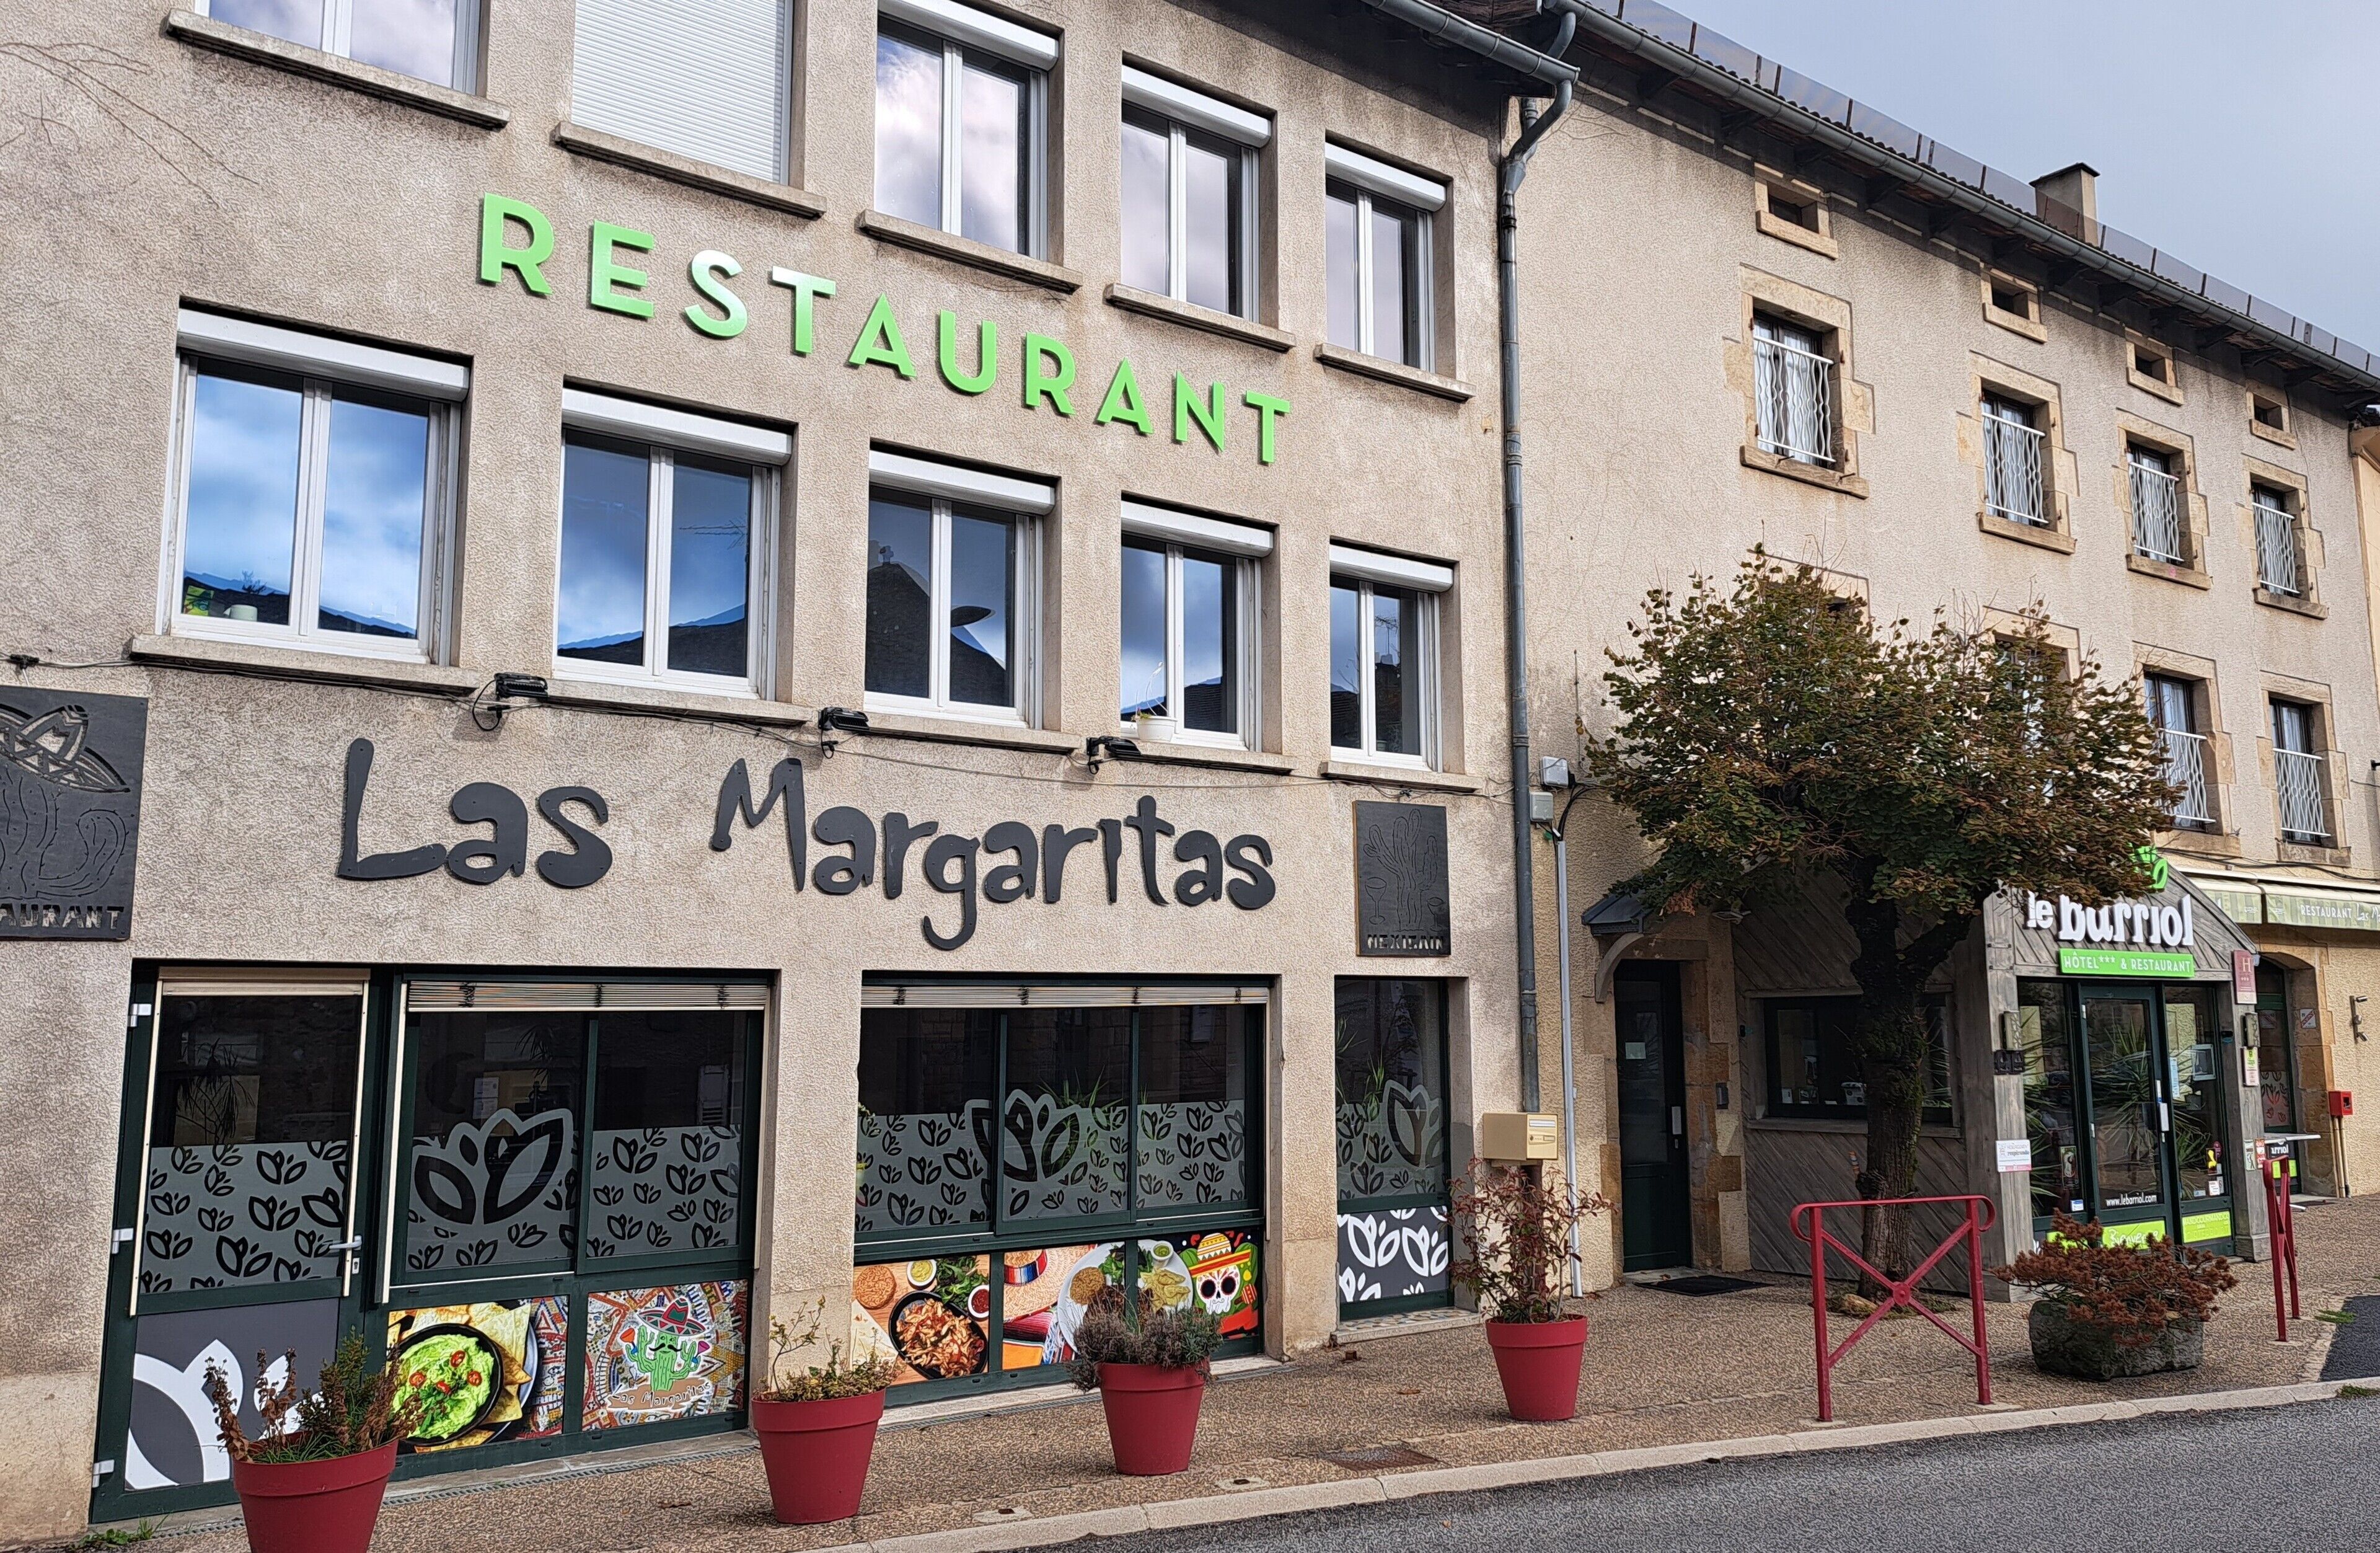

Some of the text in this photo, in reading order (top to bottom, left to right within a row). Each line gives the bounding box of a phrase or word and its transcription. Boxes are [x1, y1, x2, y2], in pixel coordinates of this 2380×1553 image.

[480, 192, 1291, 464] RESTAURANT
[336, 738, 1276, 951] Las Margaritas
[2027, 888, 2053, 929] le
[2300, 903, 2352, 919] RESTAURANT
[2356, 903, 2369, 921] Las
[1367, 934, 1445, 950] MEXICAIN
[2063, 950, 2191, 973] HÔTEL & RESTAURANT
[2242, 957, 2252, 973] H
[612, 1381, 712, 1409] Las Margaritas
